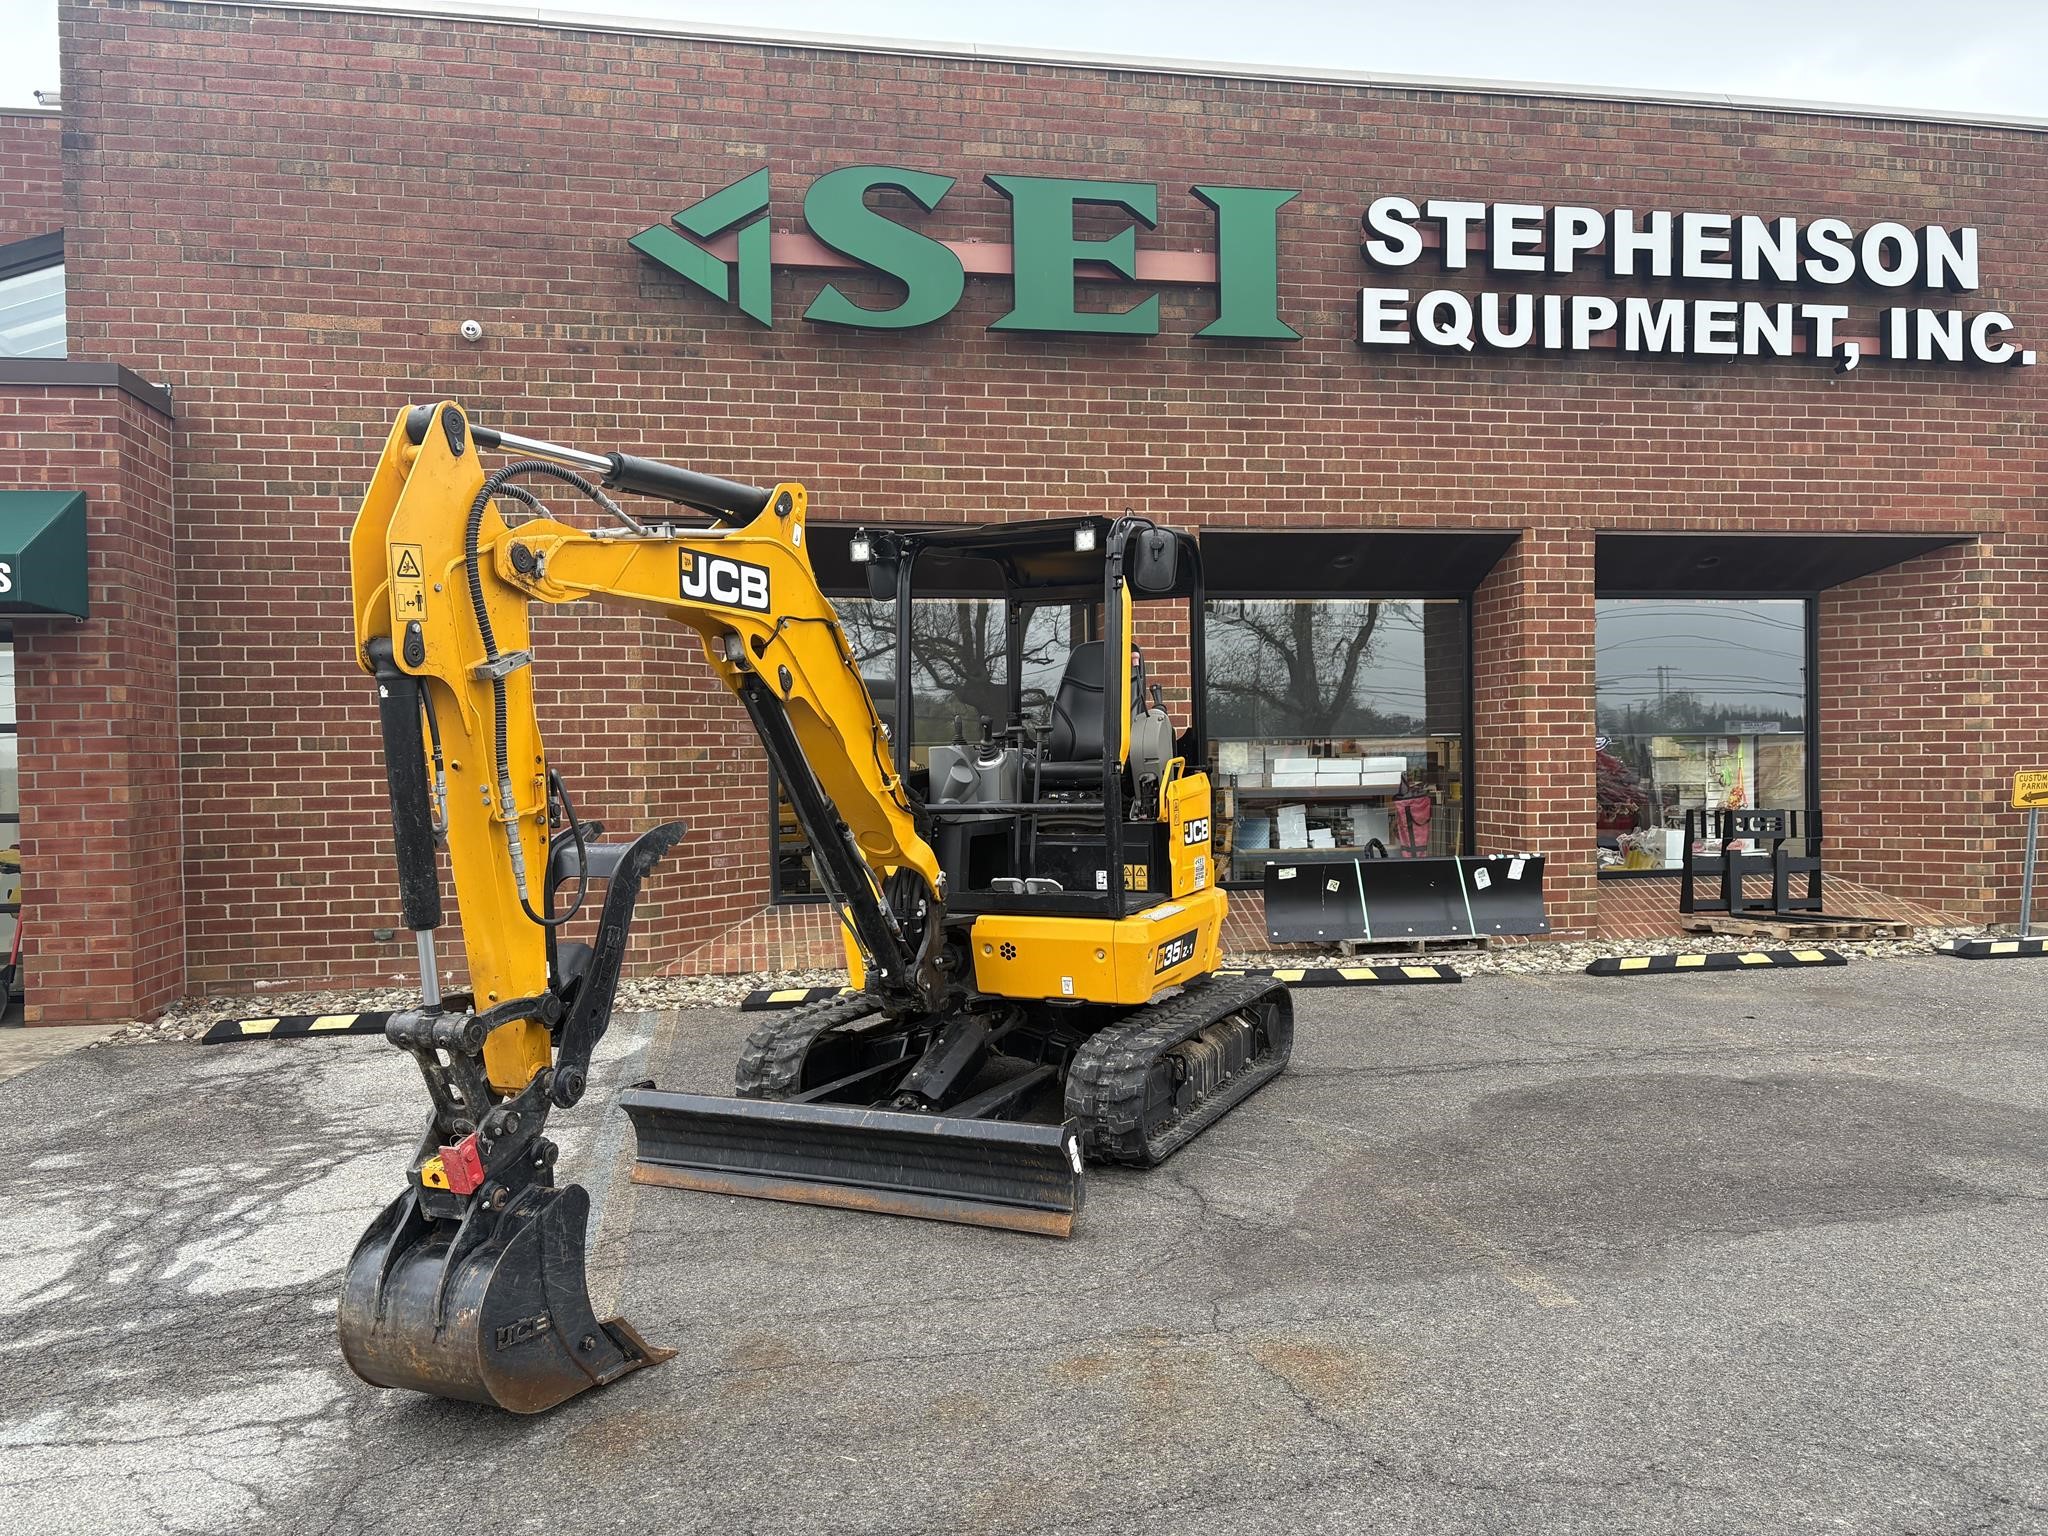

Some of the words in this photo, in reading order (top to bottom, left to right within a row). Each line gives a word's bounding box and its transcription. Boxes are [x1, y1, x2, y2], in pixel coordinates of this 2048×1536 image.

[802, 165, 1302, 340] SEI
[1365, 196, 1979, 290] STEPHENSON
[1362, 288, 1860, 371] EQUIPMENT,
[1890, 307, 2037, 365] INC.
[681, 555, 769, 609] JCB
[1184, 818, 1209, 844] JCB
[1735, 816, 1783, 832] JCB
[1163, 940, 1182, 967] 35
